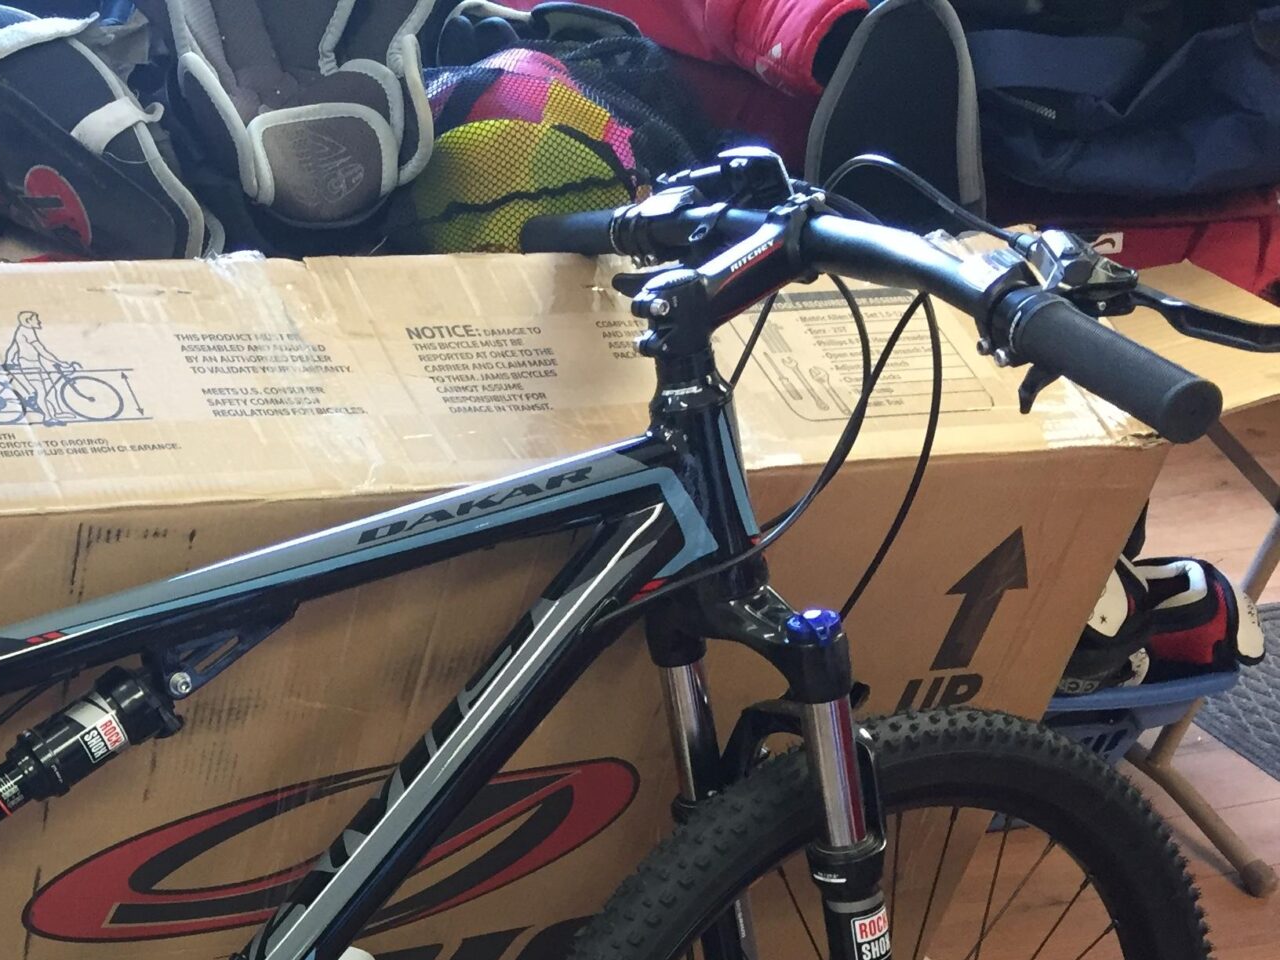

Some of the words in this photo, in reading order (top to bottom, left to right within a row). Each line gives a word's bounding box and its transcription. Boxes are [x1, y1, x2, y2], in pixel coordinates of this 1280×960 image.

[730, 239, 775, 272] RITCHEY
[174, 334, 200, 342] THIS
[201, 333, 251, 341] PRODUCT
[406, 325, 481, 340] NOTICE:
[483, 328, 526, 337] DAMAGE
[527, 327, 541, 335] TO
[181, 344, 245, 352] ASSEMBLED
[412, 343, 437, 351] THIS
[438, 341, 479, 350] BICYCLE
[481, 339, 507, 348] MUST
[510, 339, 524, 347] BE
[185, 355, 199, 363] BY
[202, 355, 218, 363] AN
[418, 353, 473, 362] REPORTED
[476, 352, 488, 360] AT
[489, 351, 518, 359] ONCE
[520, 349, 533, 357] TO
[534, 348, 554, 356] THE
[190, 366, 206, 374] TO
[208, 366, 259, 374] VALIDATE
[424, 364, 470, 373] CARRIER
[472, 363, 494, 371] AND
[495, 361, 528, 369] CLAIM
[528, 359, 558, 367] MADE
[445, 374, 479, 382] THEM.
[480, 372, 510, 381] JAMIS
[510, 370, 557, 379] BICYCLES
[240, 387, 262, 395] U.S.
[436, 384, 479, 393] CANNOT
[481, 383, 524, 392] ASSUME
[206, 398, 248, 407] SAFETY
[442, 394, 524, 404] RESPONSIBILITY
[524, 392, 547, 401] FOR
[212, 408, 290, 418] REGULATIONS
[449, 405, 493, 414] DAMAGE
[495, 404, 506, 412] IN
[507, 403, 553, 412] TRANSIT.
[45, 439, 58, 447] TO
[65, 448, 85, 456] ONE
[91, 446, 115, 454] INCH
[357, 466, 592, 545] DAKAR
[100, 719, 125, 748] ROCK
[84, 729, 108, 758] SHOX
